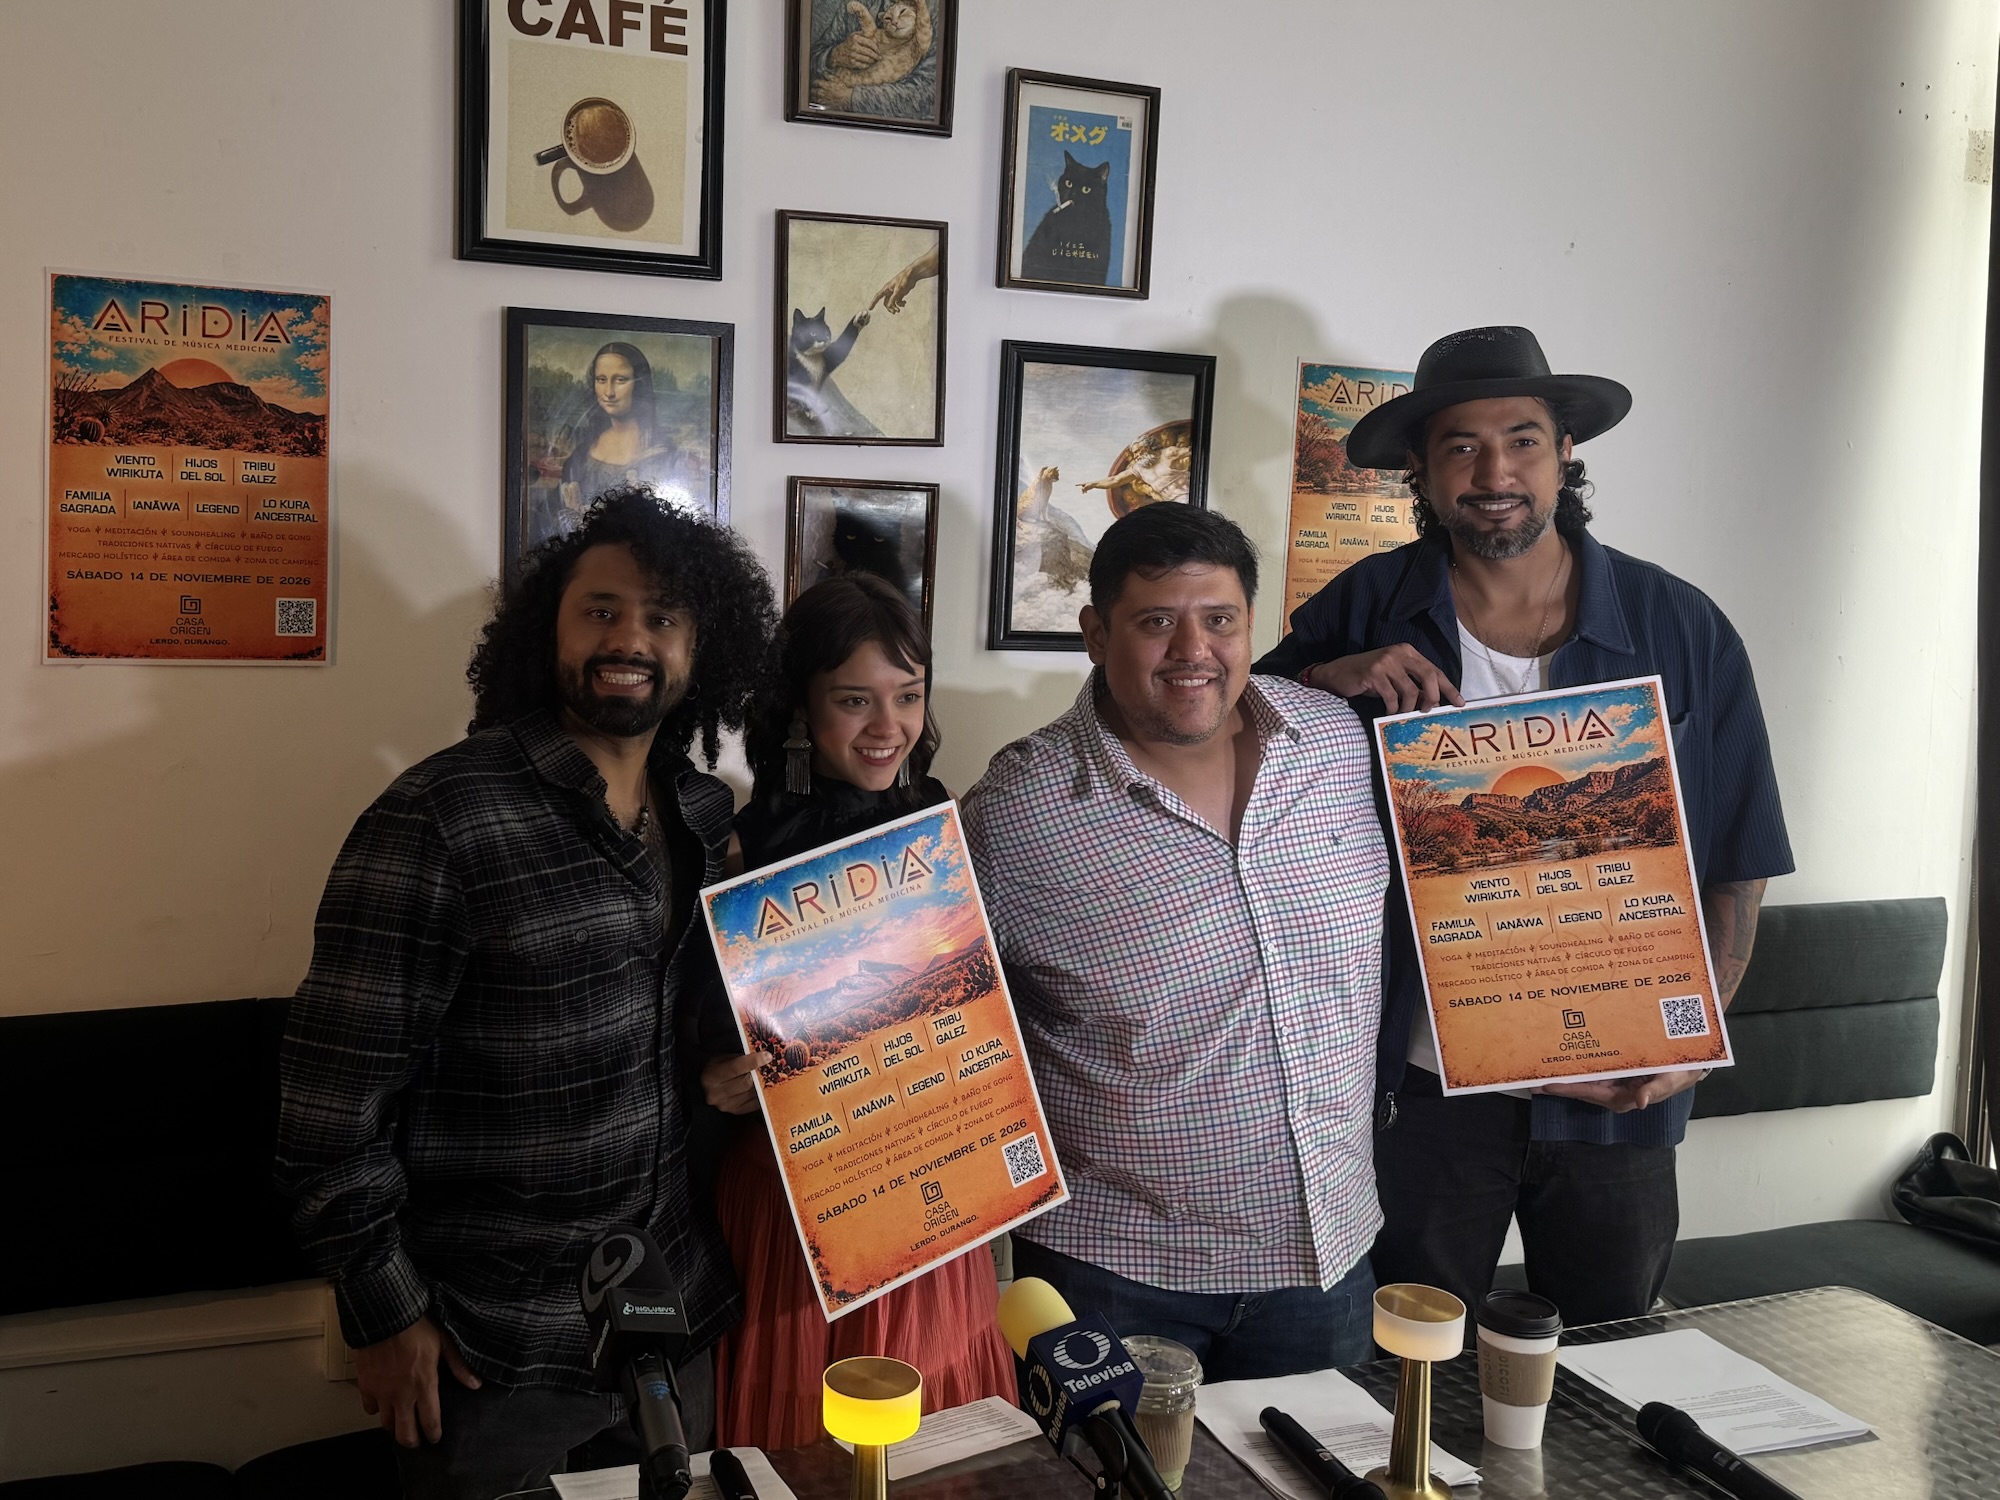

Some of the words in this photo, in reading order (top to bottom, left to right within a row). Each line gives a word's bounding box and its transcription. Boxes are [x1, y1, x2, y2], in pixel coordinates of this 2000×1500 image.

[507, 0, 688, 56] CAFÉ
[114, 455, 155, 465] VIENTO
[185, 458, 217, 468] HIJOS
[242, 461, 275, 471] TRIBU
[106, 467, 163, 479] WIRIKUTA
[180, 471, 201, 480] DEL
[204, 472, 225, 482] SOL
[241, 474, 276, 484] GALEZ
[65, 490, 111, 501] FAMILIA
[60, 503, 116, 514] SAGRADA
[196, 503, 239, 514] LEGEND
[263, 499, 276, 508] LO
[280, 499, 310, 509] KURA
[1331, 503, 1357, 511] VIENTO
[1374, 505, 1395, 513] HIJOS
[254, 511, 318, 522] ANCESTRAL
[1326, 513, 1361, 521] WIRIKUTA
[1371, 515, 1384, 523] DEL
[1386, 515, 1399, 523] SOL
[1299, 530, 1328, 538] FAMILIA
[1295, 540, 1329, 548] SAGRADA
[67, 568, 122, 580] SÁBADO
[130, 572, 143, 580] 14
[149, 572, 167, 581] DE
[173, 573, 251, 583] NOVIEMBRE
[256, 575, 273, 584] DE
[279, 576, 310, 585] 2026
[175, 617, 204, 625] CASA
[169, 626, 210, 635] ORIGEN
[1596, 861, 1630, 873] TRIBU
[1538, 869, 1571, 881] HIJOS
[1598, 874, 1634, 886] GALEZ
[1470, 877, 1510, 889] VIENTO
[1536, 884, 1557, 894] DEL
[1560, 881, 1582, 891] SOL
[1464, 889, 1520, 902] WIRIKUTA
[1624, 898, 1638, 907] LO
[1642, 894, 1674, 905] KURA
[1558, 910, 1602, 923] LEGEND
[1618, 906, 1685, 921] ANCESTRAL
[1431, 918, 1475, 930] FAMILIA
[1429, 930, 1482, 944] SAGRADA
[1475, 945, 1525, 958] MEDITACIÓN
[1538, 937, 1603, 950] SOUNDHEALING
[1618, 932, 1641, 941] BAÑO
[1657, 928, 1682, 936] GONG
[1470, 959, 1524, 971] TRADICIONES
[1526, 955, 1561, 964] NATIVAS
[1575, 949, 1611, 959] CÍRCULO
[1626, 944, 1654, 952] FUEGO
[1437, 978, 1476, 988] MERCADO
[1478, 973, 1522, 983] HOLÍSTICO
[1534, 968, 1556, 976] ÁREA
[1570, 963, 1604, 972] COMIDA
[1617, 959, 1641, 967] ZONA
[1656, 952, 1695, 962] CAMPING
[1448, 994, 1501, 1007] SÁBADO
[1509, 992, 1522, 1001] 14
[1527, 989, 1545, 999] DE
[1550, 979, 1628, 996] NOVIEMBRE
[1634, 976, 1652, 986] DE
[1658, 972, 1691, 984] 2026
[932, 1011, 961, 1030] TRIBU
[936, 1024, 967, 1044] GALEZ
[1562, 1030, 1592, 1041] CASA
[883, 1032, 912, 1052] HIJOS
[1559, 1039, 1600, 1051] ORIGEN
[883, 1053, 903, 1067] DEL
[904, 1044, 924, 1058] SOL
[960, 1050, 974, 1062] LO
[975, 1038, 1002, 1056] KURA
[822, 1055, 859, 1077] VIENTO
[959, 1049, 1013, 1079] ANCESTRAL
[818, 1066, 871, 1095] WIRIKUTA
[906, 1072, 945, 1095] LEGEND
[790, 1112, 832, 1137] FAMILIA
[789, 1125, 840, 1154] SAGRADA
[817, 1193, 866, 1223] SÁBADO
[872, 1184, 885, 1197] 14
[889, 1174, 906, 1189] DE
[909, 1141, 976, 1179] NOVIEMBRE
[979, 1132, 996, 1146] DE
[999, 1118, 1027, 1137] 2026
[924, 1201, 951, 1219] CASA
[923, 1207, 959, 1231] ORIGEN
[1064, 1361, 1135, 1393] Televisa
[1049, 1391, 1068, 1444] Televisa
